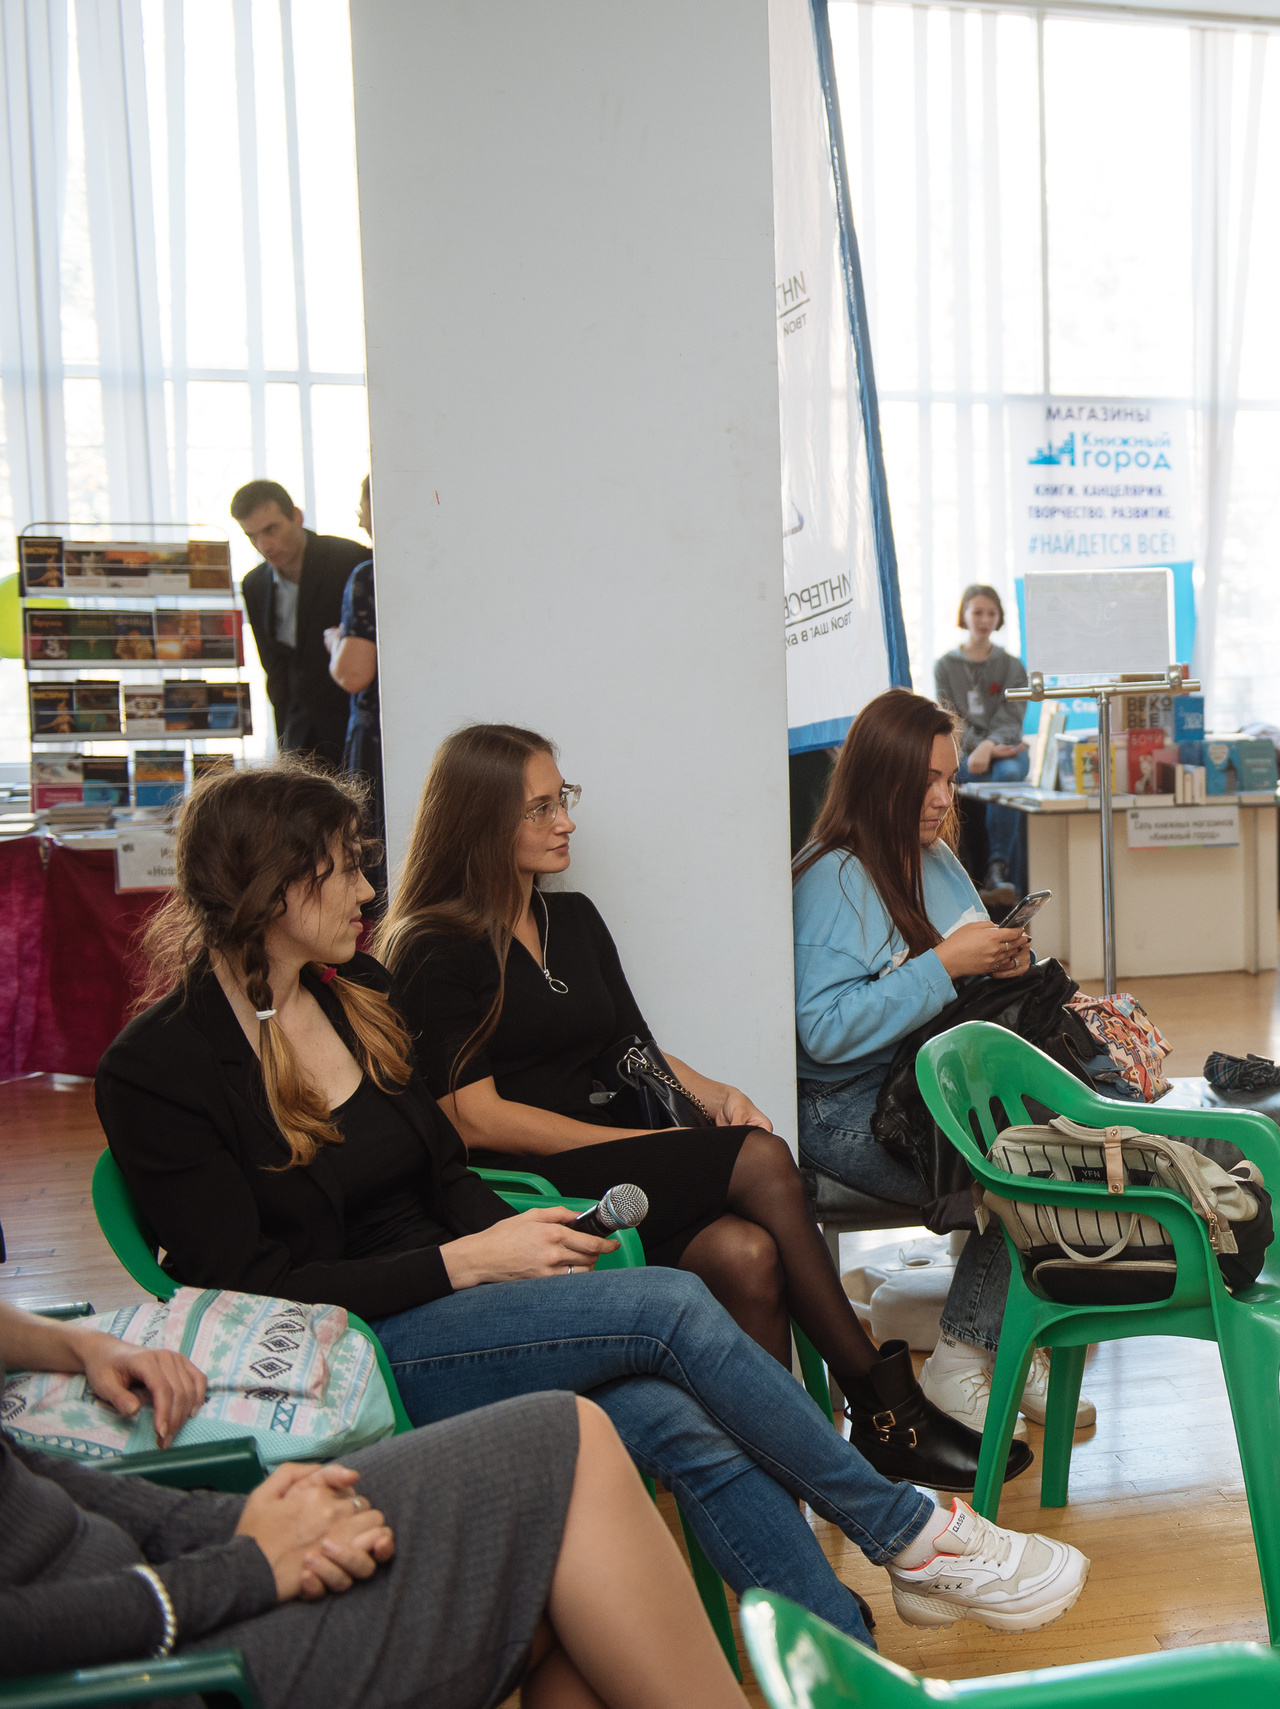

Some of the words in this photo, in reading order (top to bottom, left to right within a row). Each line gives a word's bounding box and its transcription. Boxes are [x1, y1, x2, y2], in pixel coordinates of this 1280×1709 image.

[1046, 405, 1151, 422] МАГАЗИНЫ
[1082, 431, 1172, 448] Книжный
[1083, 450, 1172, 473] город
[1137, 530, 1176, 554] ВСЁ!
[1081, 1169, 1101, 1178] YFN
